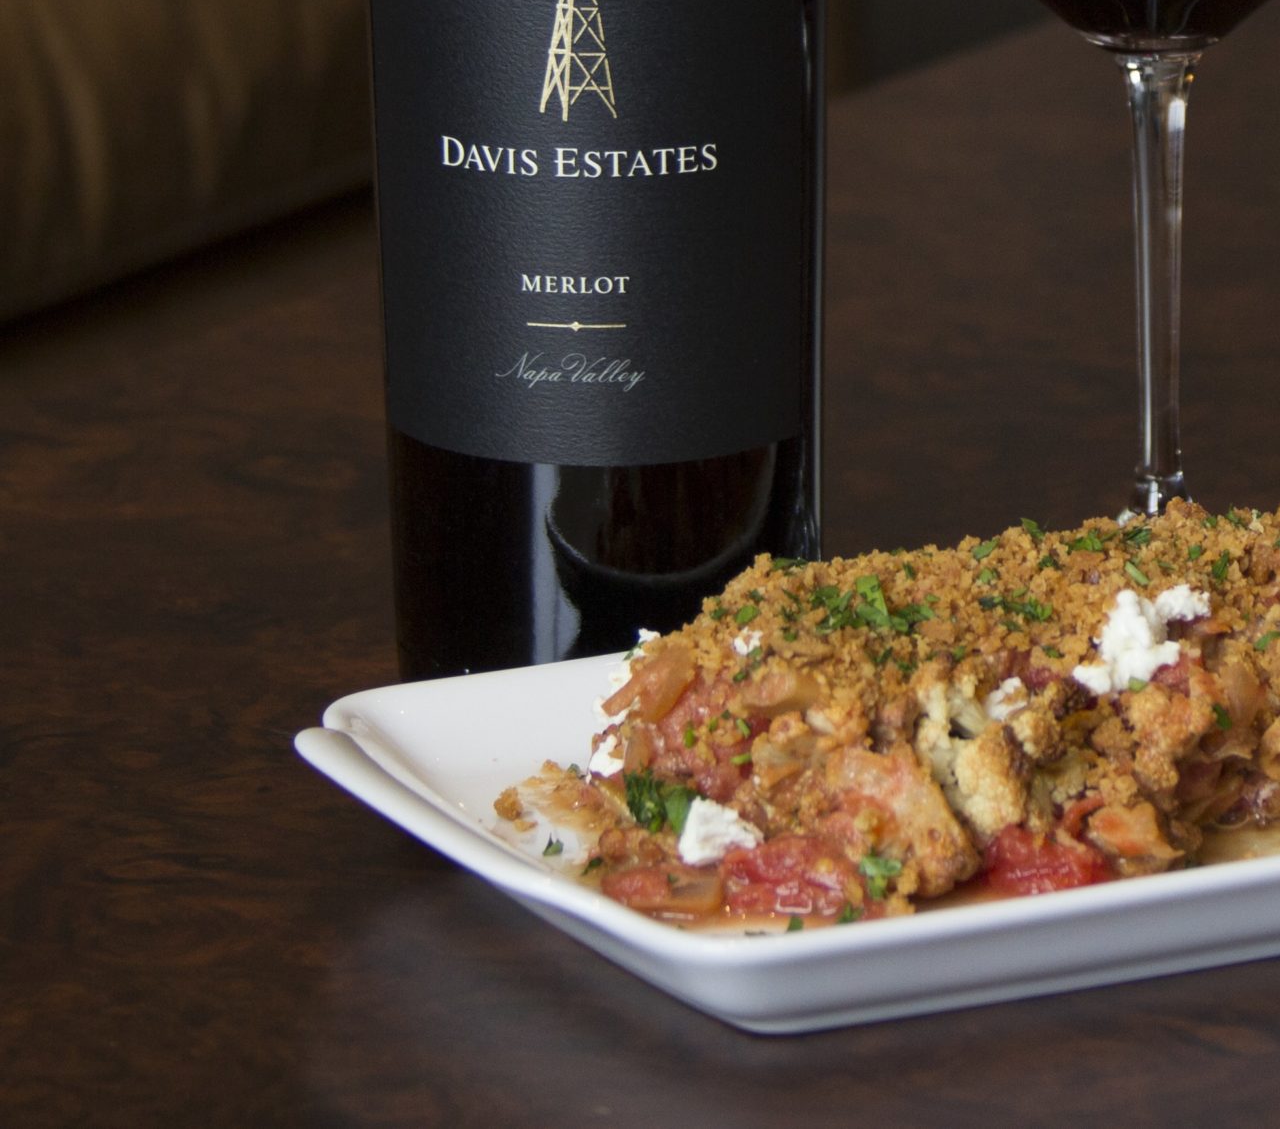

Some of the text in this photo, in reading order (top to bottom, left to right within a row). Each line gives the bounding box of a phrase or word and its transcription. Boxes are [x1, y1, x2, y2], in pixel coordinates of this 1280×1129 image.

[442, 135, 718, 178] DAVIS ESTATES
[521, 274, 630, 294] MERLOT
[495, 351, 645, 392] Napa Valley
